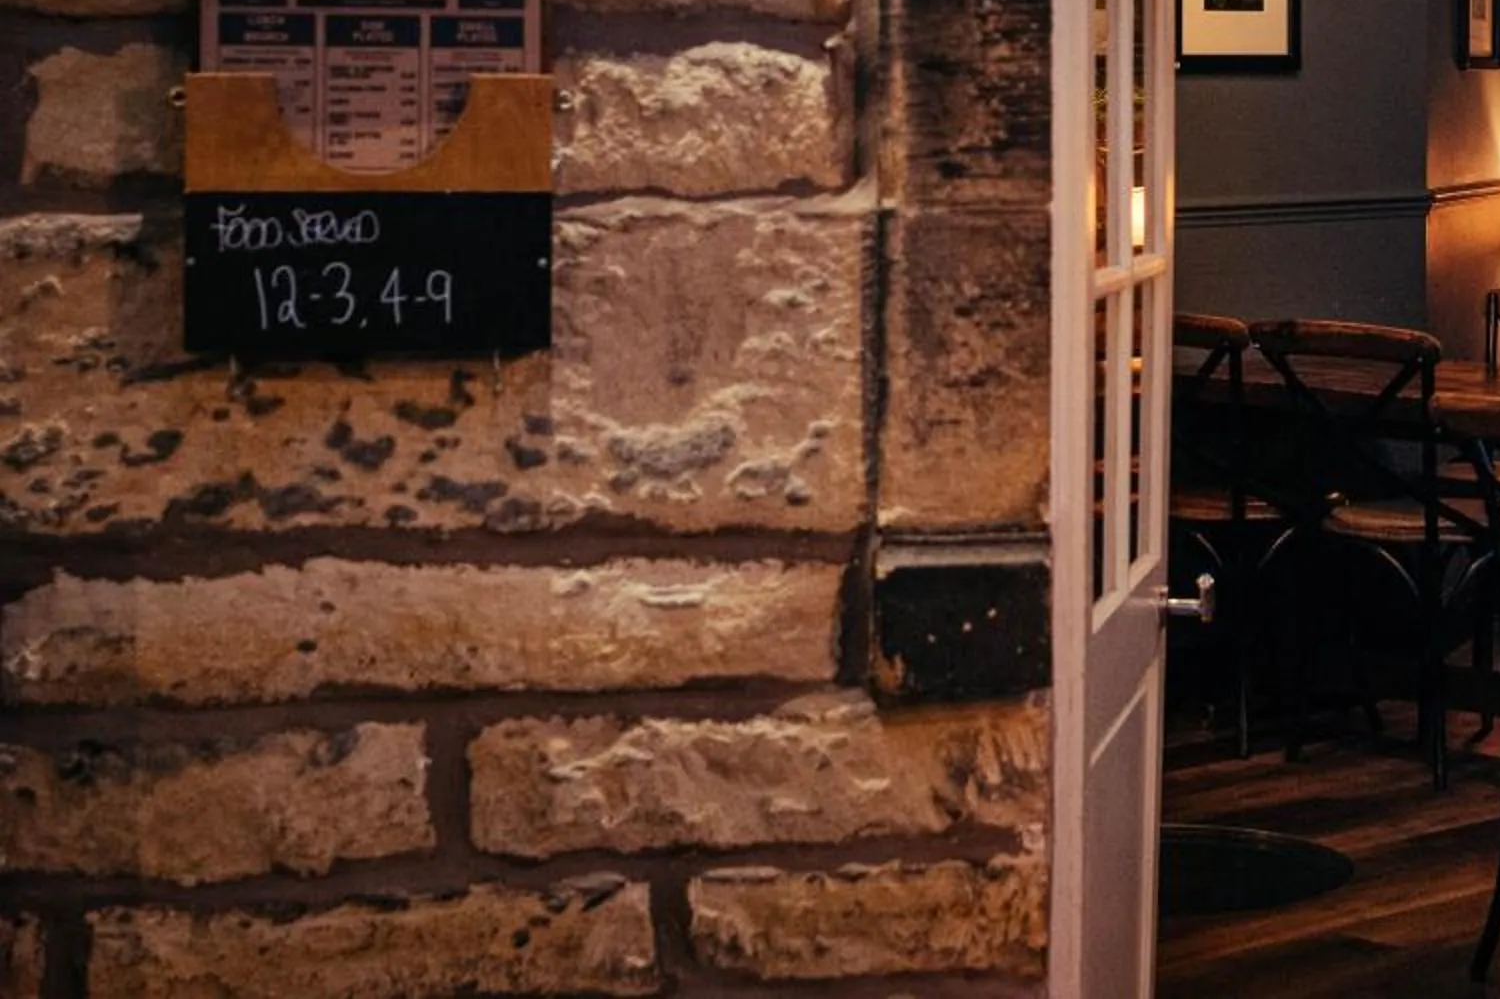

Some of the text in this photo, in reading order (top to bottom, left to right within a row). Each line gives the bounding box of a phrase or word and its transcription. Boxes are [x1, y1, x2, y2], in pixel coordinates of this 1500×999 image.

[210, 203, 379, 252] FOOD SERVED
[380, 267, 453, 326] 4-9
